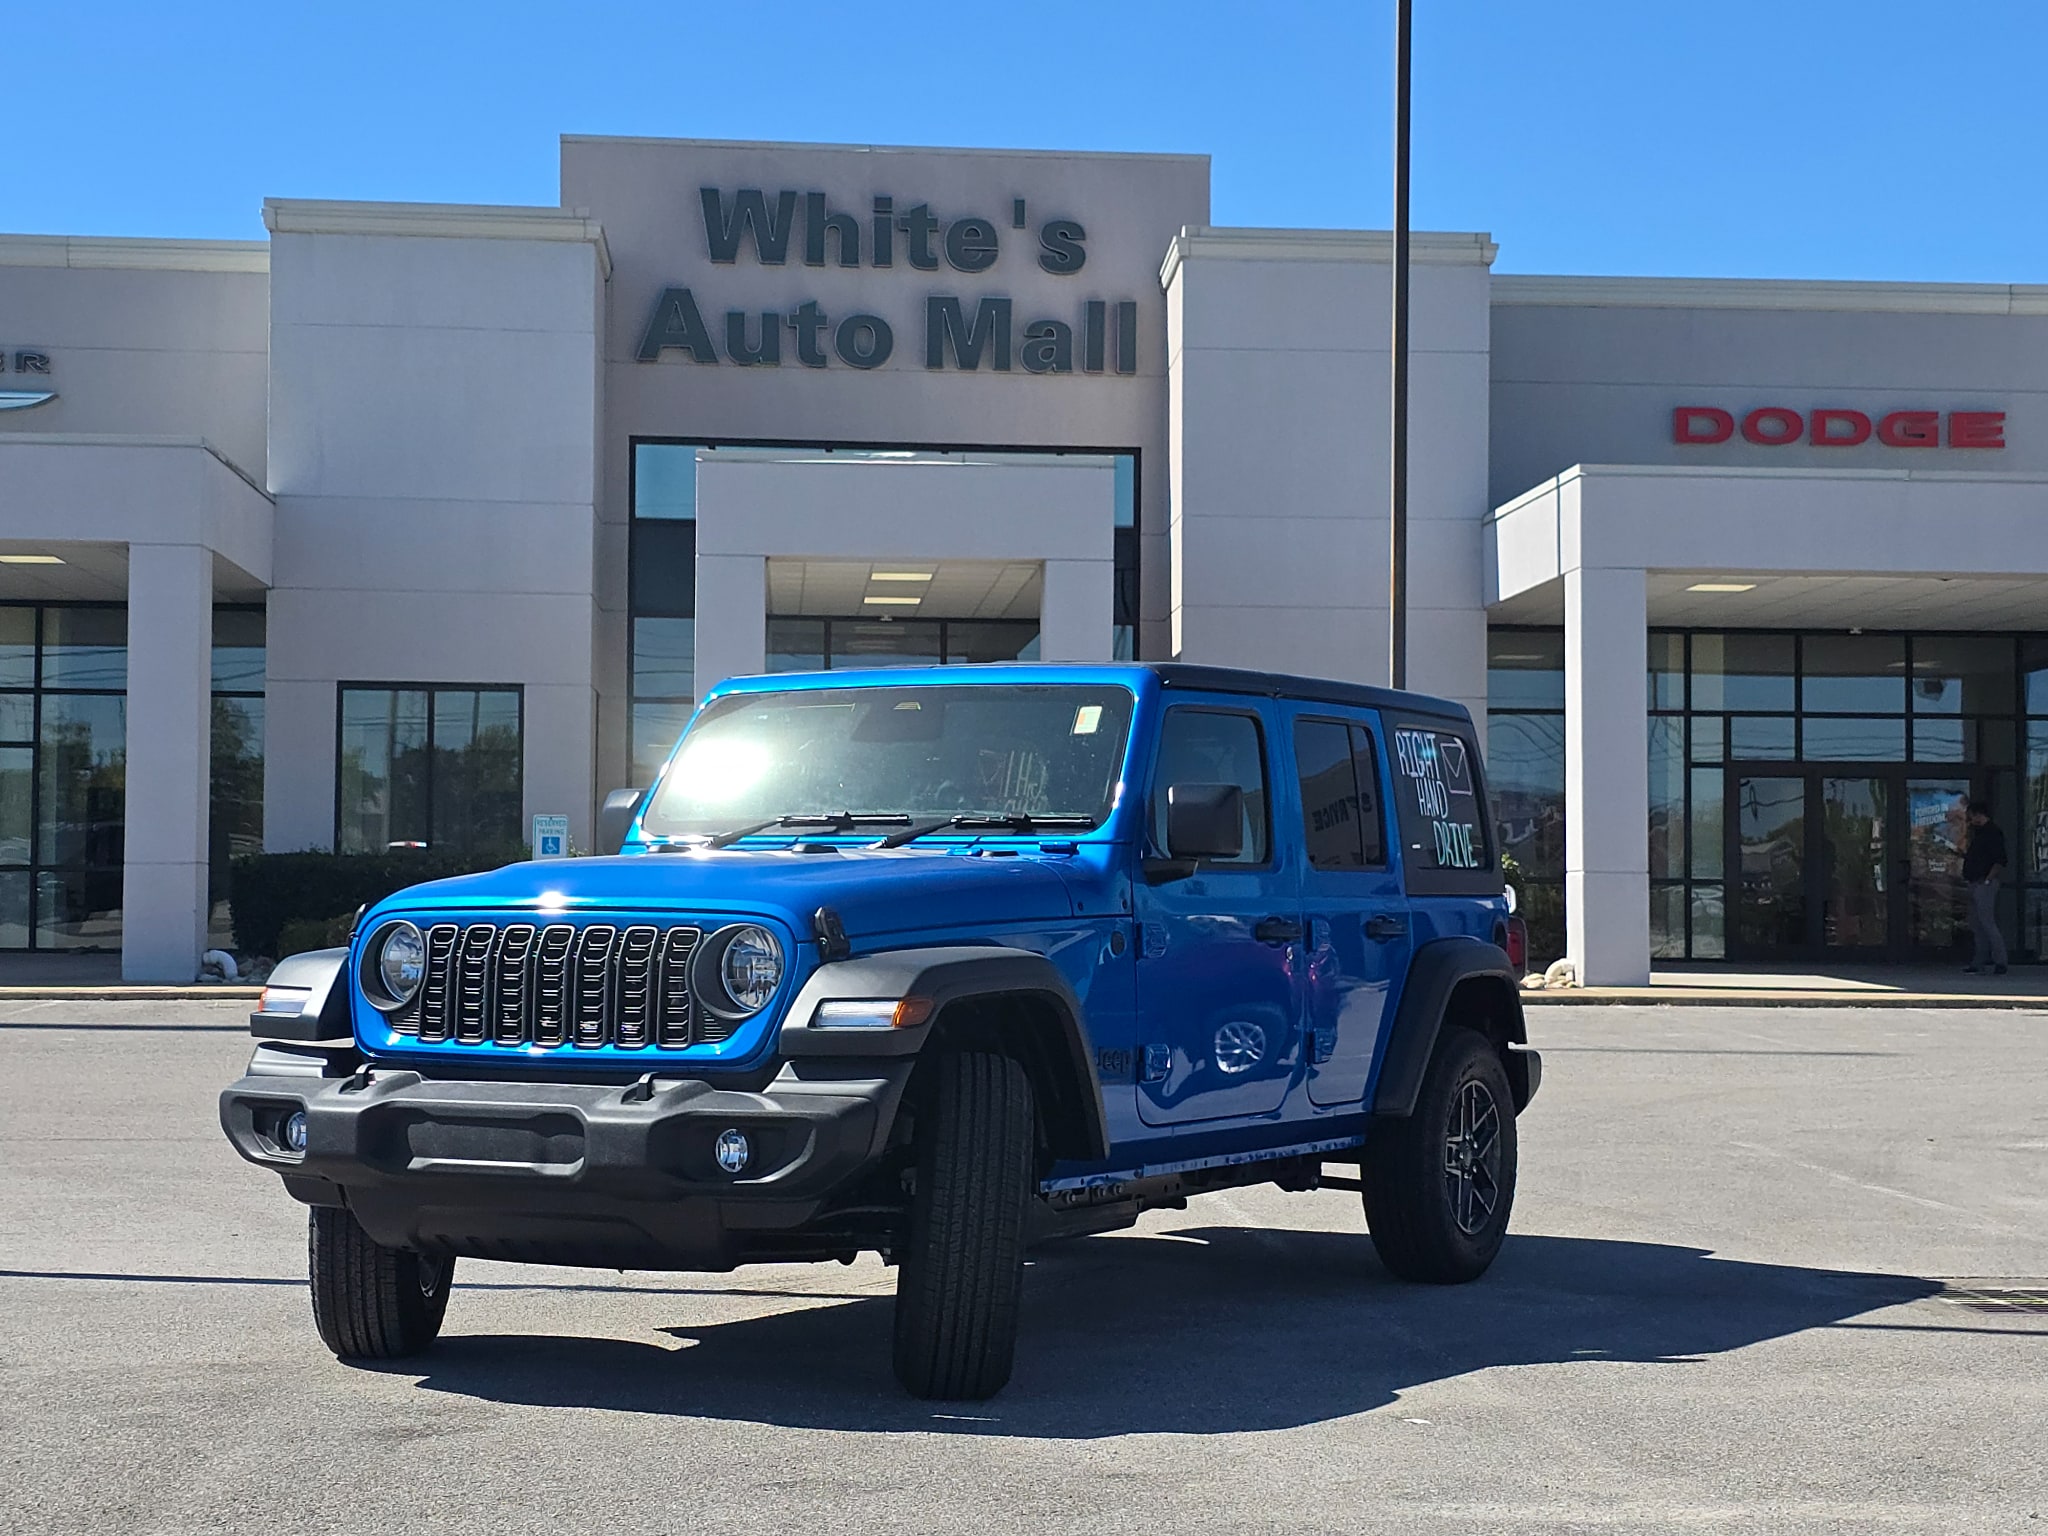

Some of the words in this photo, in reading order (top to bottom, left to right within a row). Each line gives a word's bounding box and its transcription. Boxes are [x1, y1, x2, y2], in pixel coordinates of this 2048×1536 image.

[700, 188, 1087, 275] White's
[636, 287, 894, 369] Auto
[925, 296, 1137, 375] Mall
[1673, 406, 2006, 449] DODGE
[1395, 731, 1440, 780] RIGHT
[1416, 777, 1449, 819] HAND
[1433, 821, 1478, 868] DRIVE
[1096, 1046, 1130, 1074] Jeep
